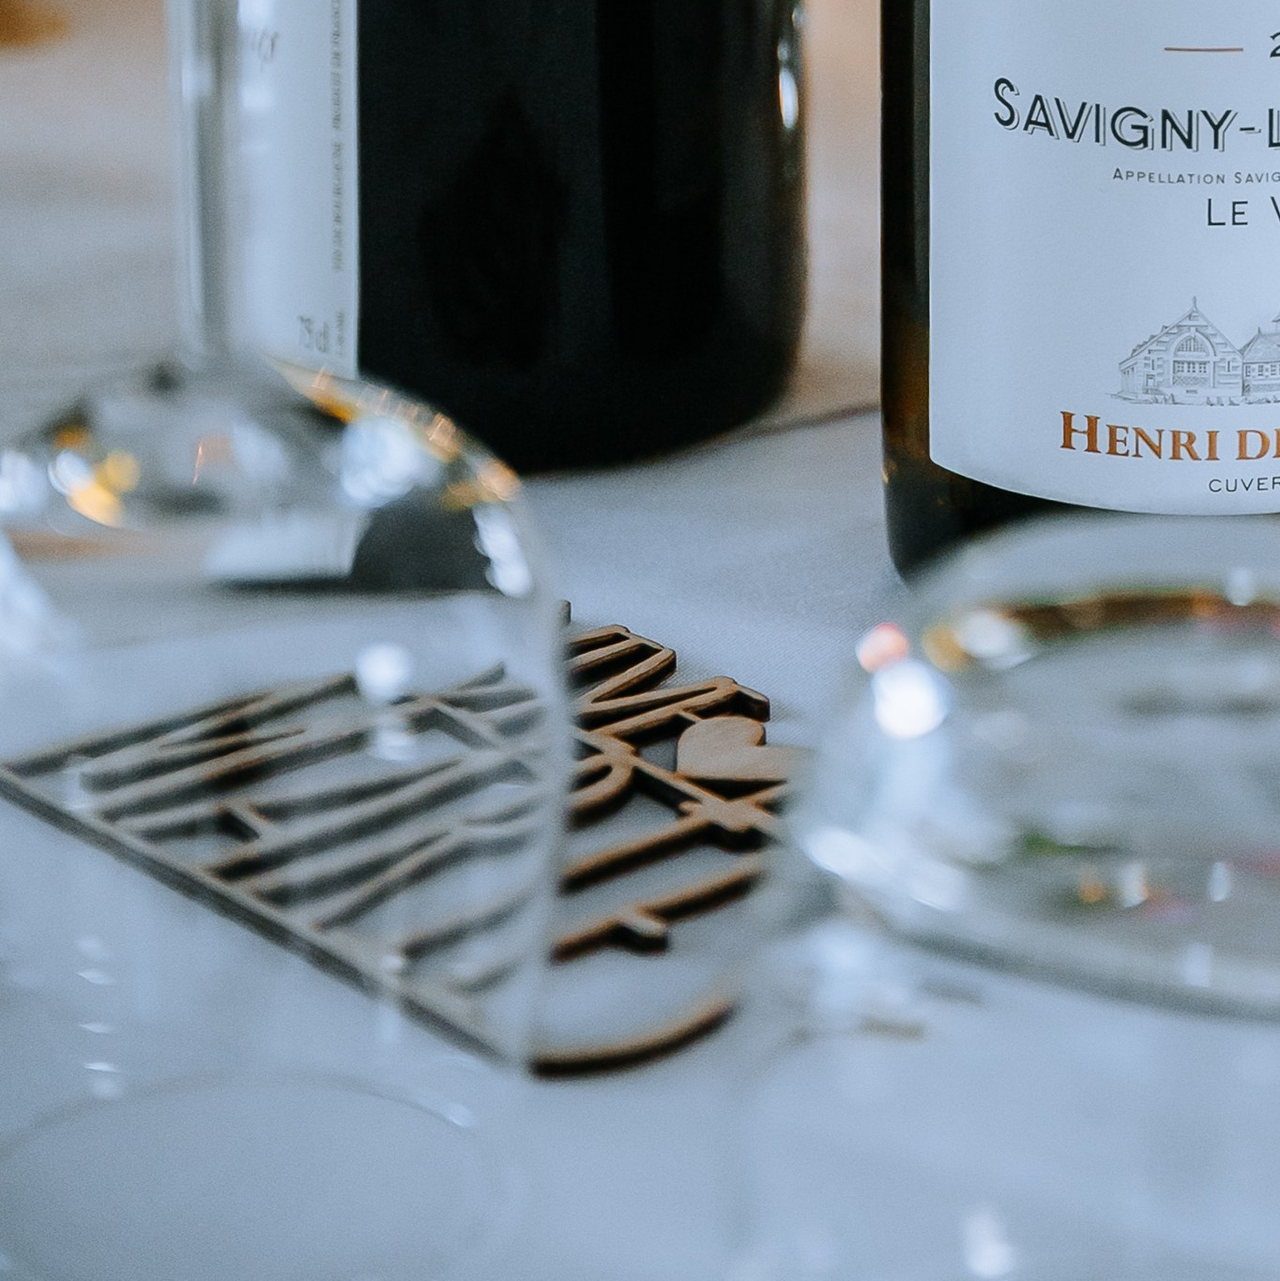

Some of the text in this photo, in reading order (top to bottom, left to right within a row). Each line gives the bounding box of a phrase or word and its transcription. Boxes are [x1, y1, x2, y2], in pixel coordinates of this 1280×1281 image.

[1112, 167, 1227, 185] APPELLATION
[1207, 198, 1250, 227] LE
[1059, 410, 1221, 462] HENRI
